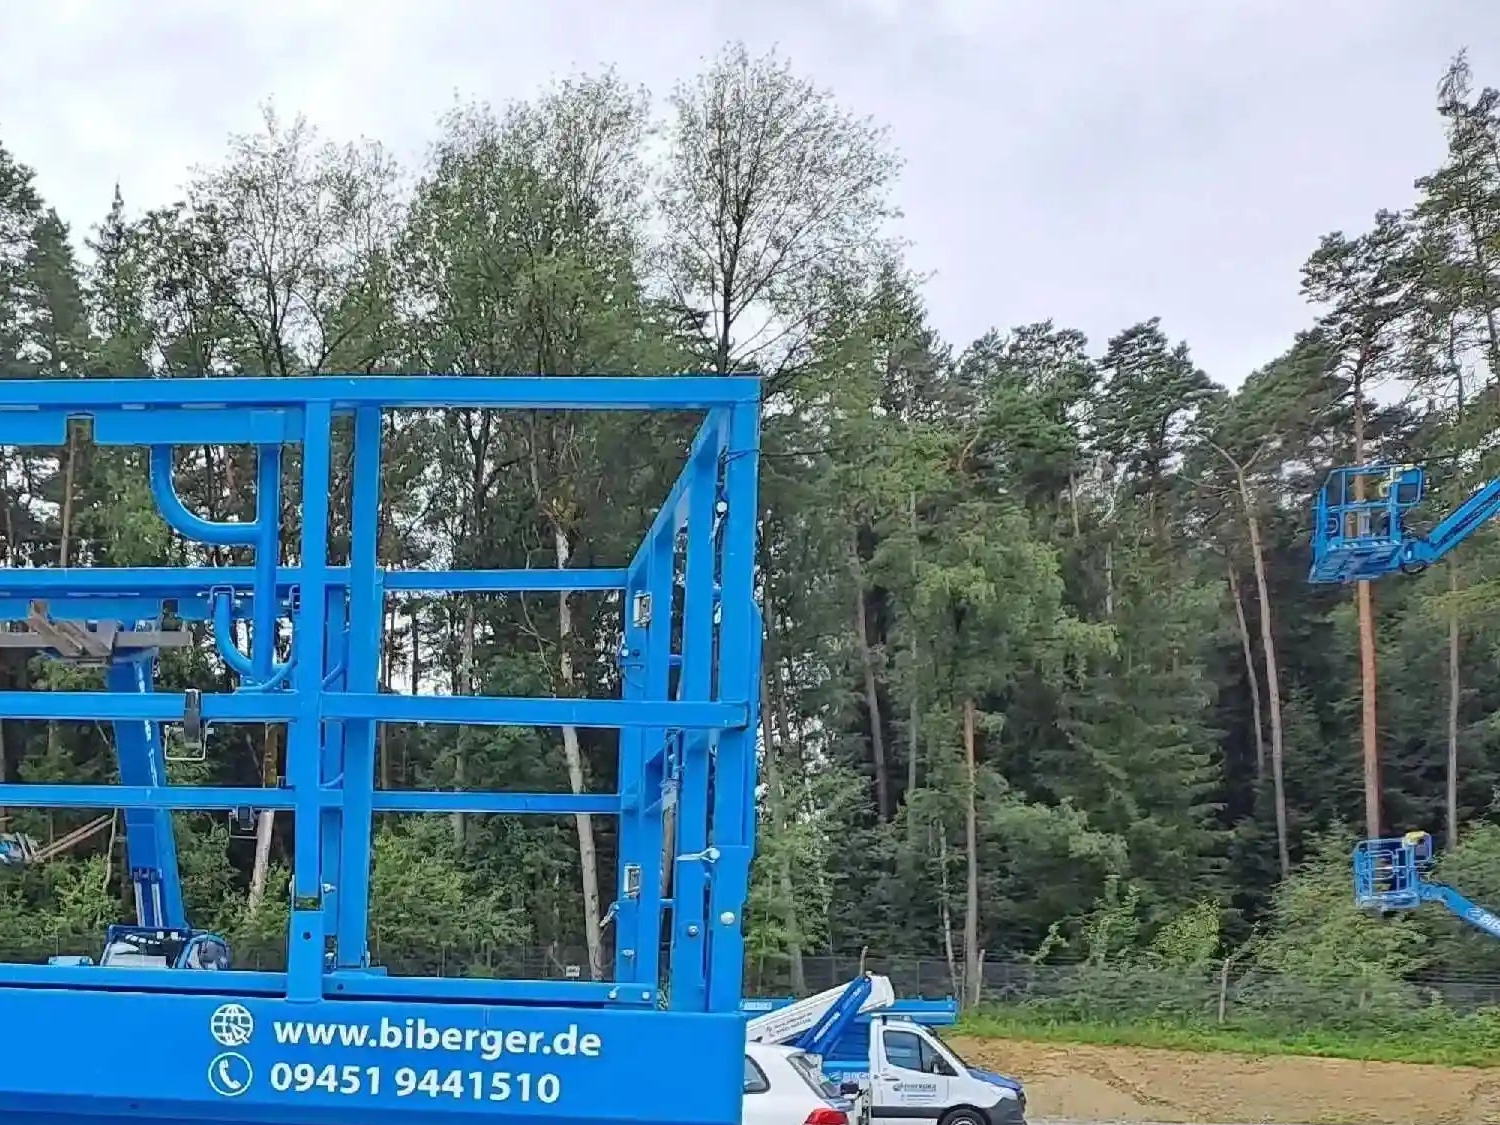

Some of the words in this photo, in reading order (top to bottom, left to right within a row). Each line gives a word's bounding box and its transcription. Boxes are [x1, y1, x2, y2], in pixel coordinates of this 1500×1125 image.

[273, 1016, 601, 1060] www.biberger.de
[270, 1062, 380, 1095] 09451
[395, 1067, 561, 1104] 9441510
